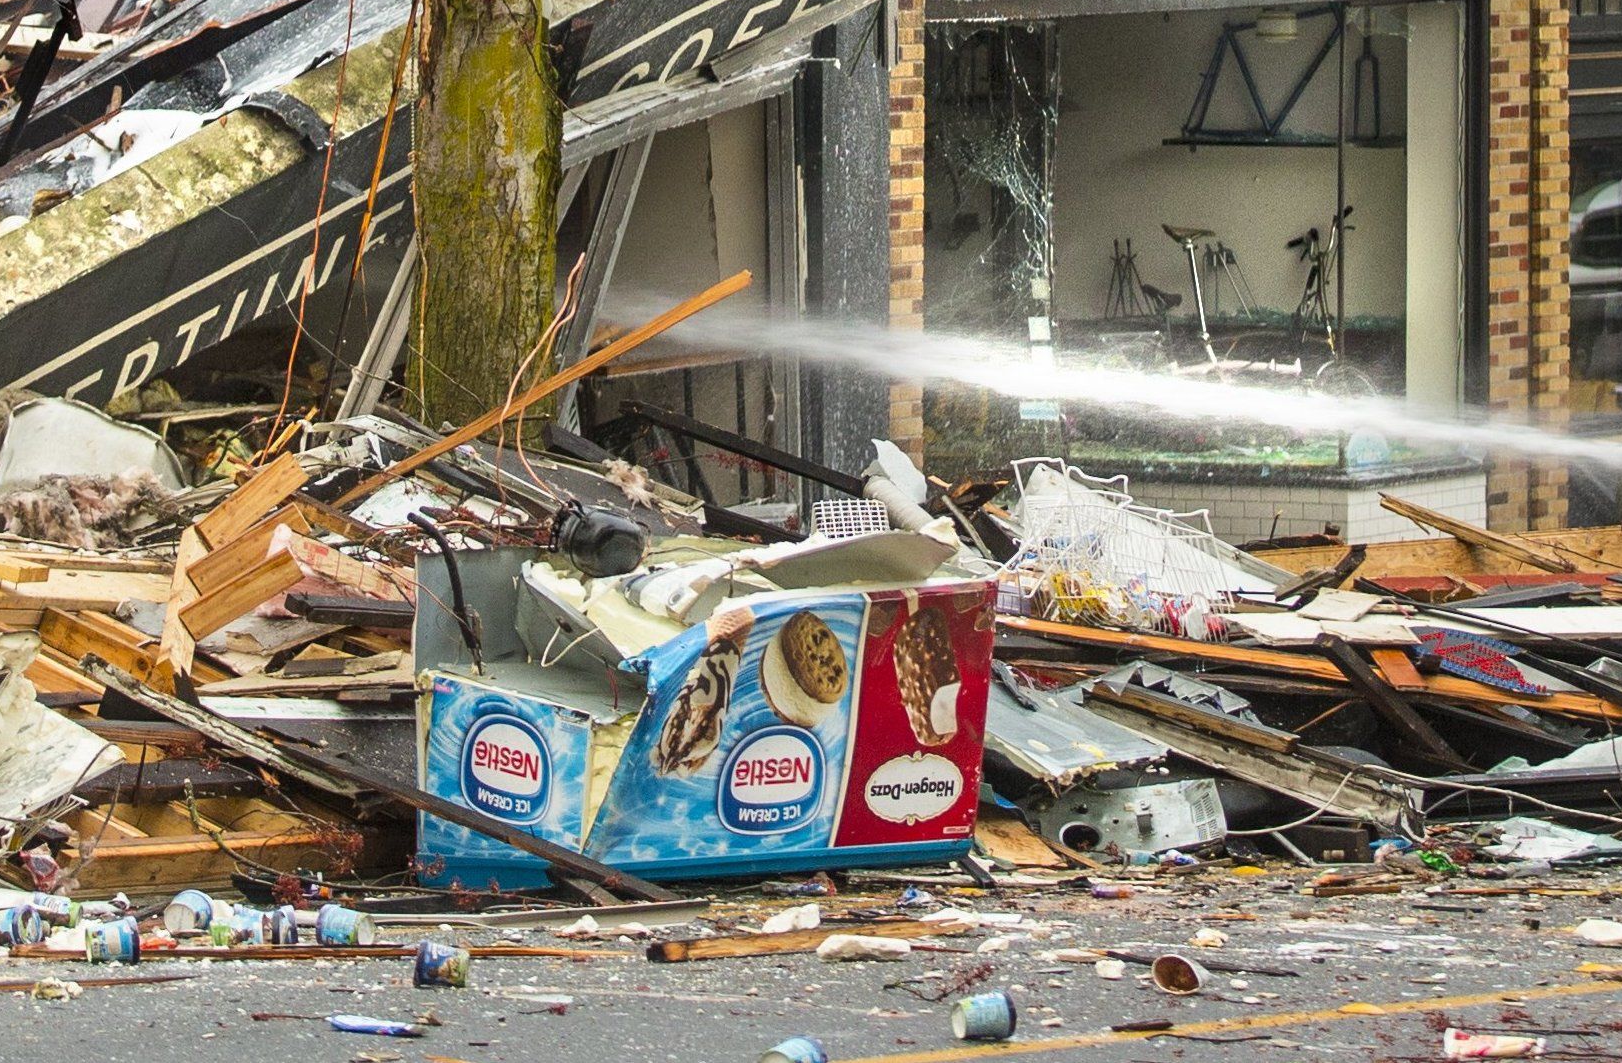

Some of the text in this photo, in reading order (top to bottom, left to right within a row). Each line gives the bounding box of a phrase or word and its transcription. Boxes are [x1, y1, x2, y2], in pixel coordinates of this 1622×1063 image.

[478, 786, 531, 814] ICE CREAM
[870, 776, 955, 801] Häagen-Dazs
[738, 804, 801, 823] ICE CREAM
